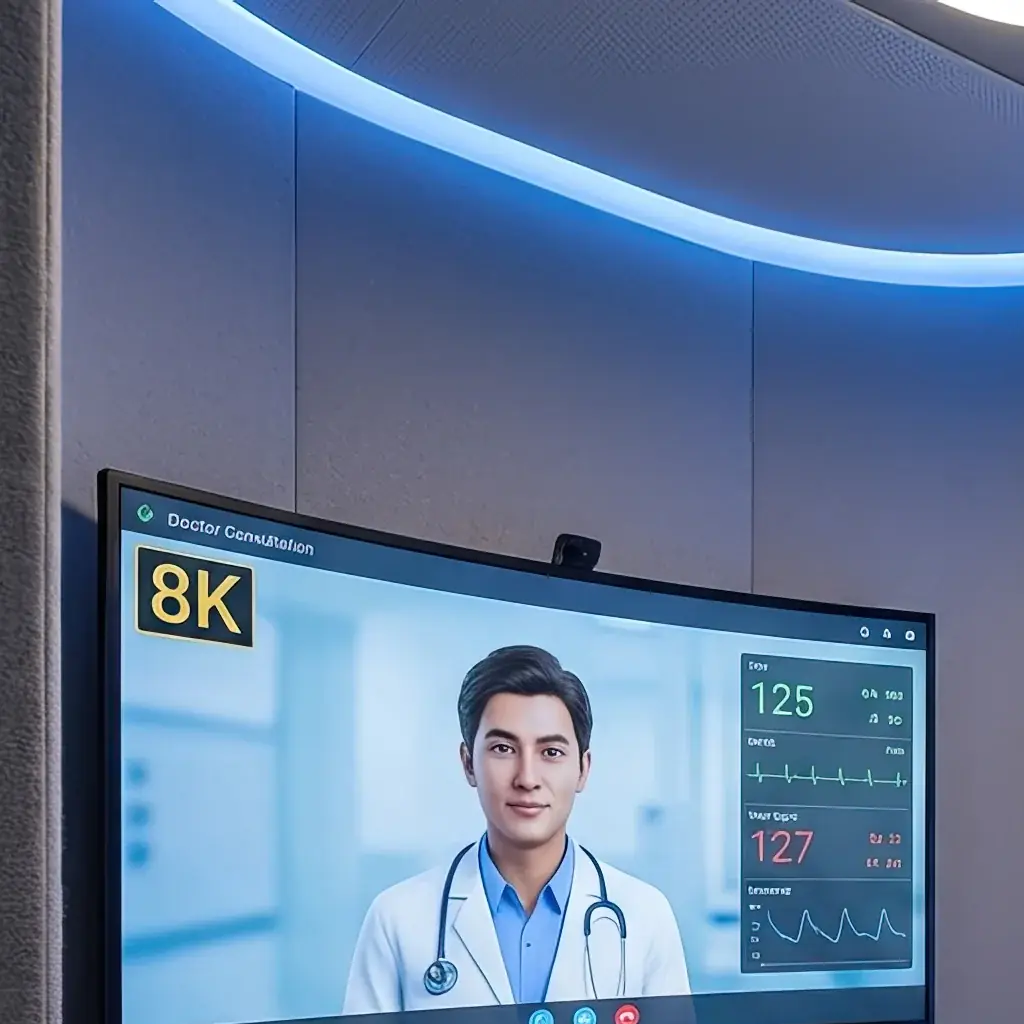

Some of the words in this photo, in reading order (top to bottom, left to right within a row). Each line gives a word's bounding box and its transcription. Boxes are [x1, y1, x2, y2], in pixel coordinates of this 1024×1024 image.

[167, 513, 221, 536] Doctor
[150, 563, 242, 635] 8K
[751, 681, 815, 718] 125
[751, 830, 815, 864] 127
